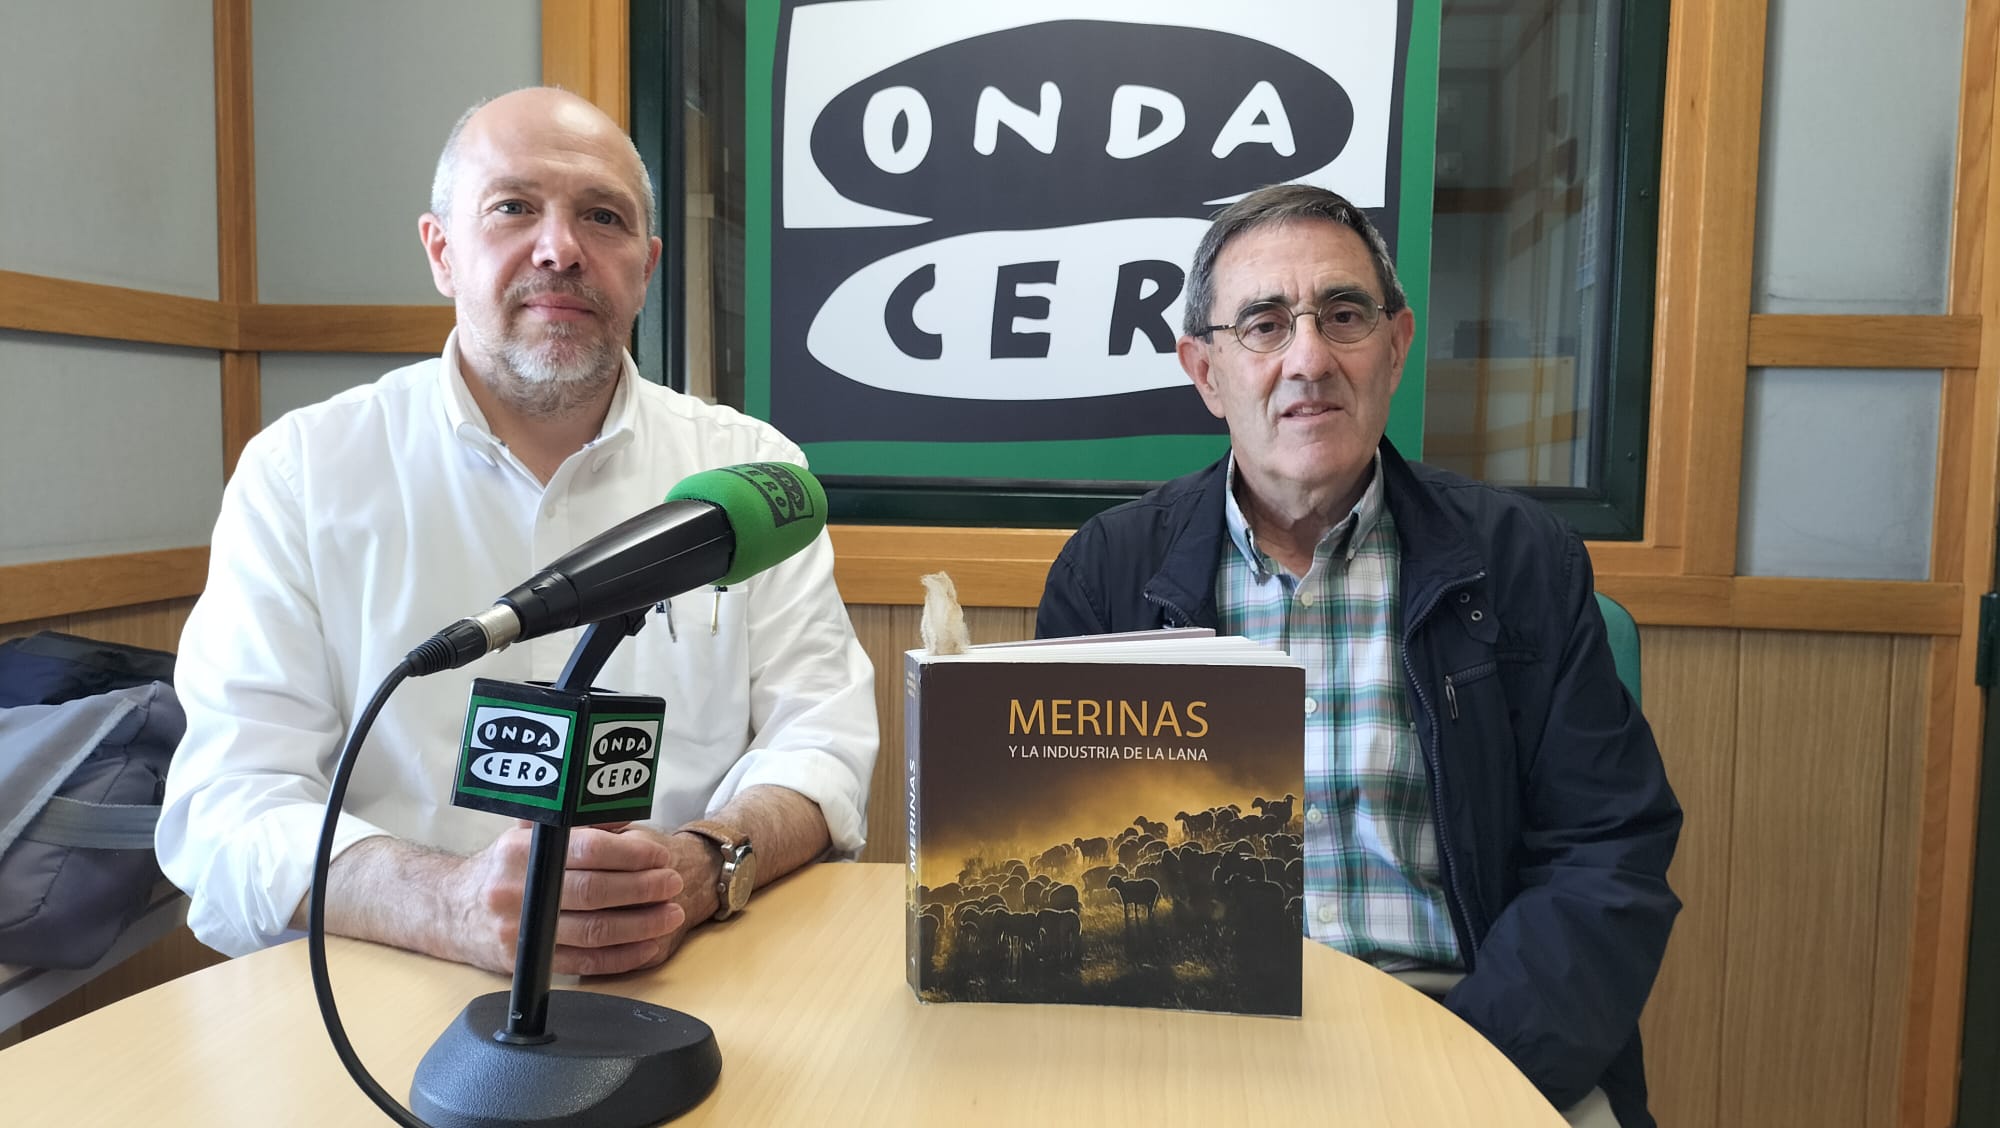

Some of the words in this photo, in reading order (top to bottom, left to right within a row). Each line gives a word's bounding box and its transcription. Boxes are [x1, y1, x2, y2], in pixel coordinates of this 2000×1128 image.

[862, 80, 1297, 174] ONDA
[884, 259, 1186, 360] CER
[755, 463, 801, 503] NDA
[1008, 698, 1209, 738] MERINAS
[484, 723, 552, 748] ONDA
[598, 736, 647, 755] ONDA
[1008, 745, 1018, 758] Y
[1021, 745, 1039, 758] LA
[1043, 745, 1120, 759] INDUSTRIA
[1124, 747, 1143, 760] DE
[1146, 748, 1164, 760] LA
[1168, 748, 1208, 761] LANA
[483, 758, 547, 782] CERO
[597, 765, 643, 789] CERO
